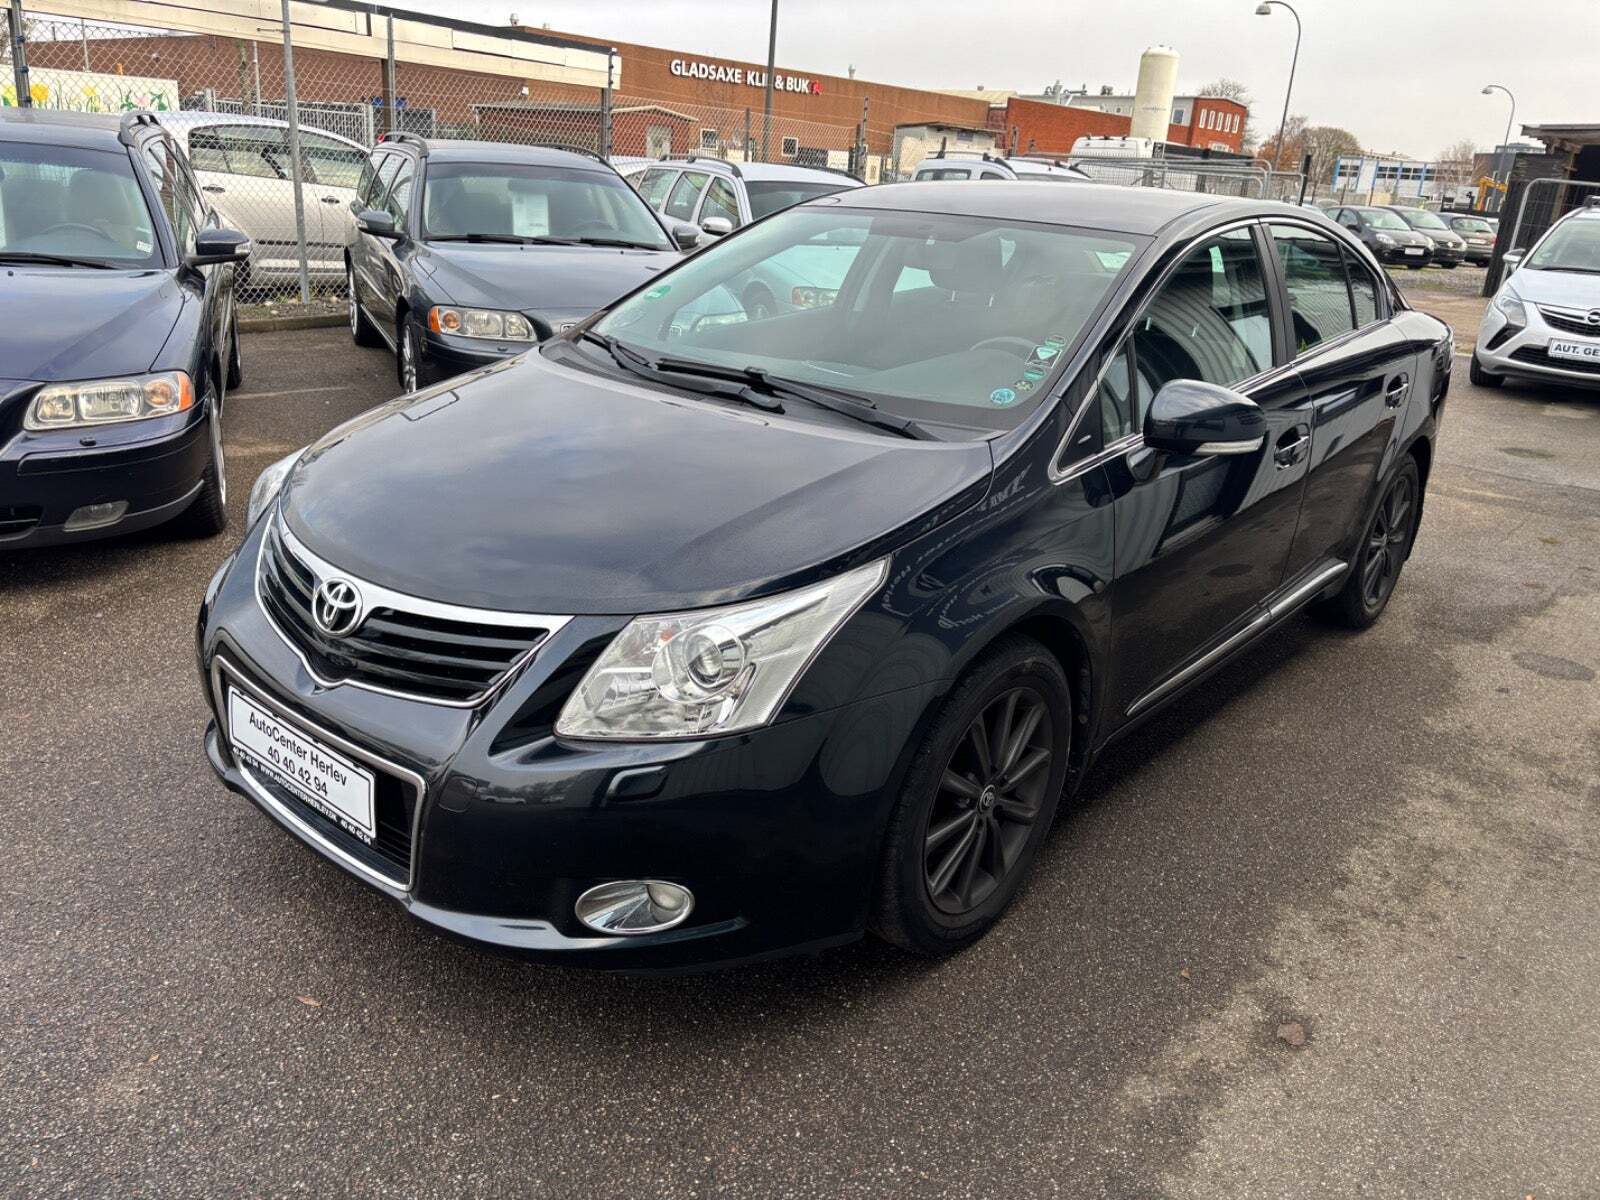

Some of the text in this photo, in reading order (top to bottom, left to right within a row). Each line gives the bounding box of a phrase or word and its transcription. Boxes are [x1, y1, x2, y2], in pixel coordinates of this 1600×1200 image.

[670, 59, 809, 94] GLADSAXE KLI & BUK
[1554, 343, 1580, 354] AUT.
[249, 711, 308, 760] AutoCenter
[310, 750, 347, 786] Herlev
[268, 746, 280, 764] 40
[283, 756, 295, 774] 40
[298, 767, 312, 786] 42
[314, 776, 328, 796] 94
